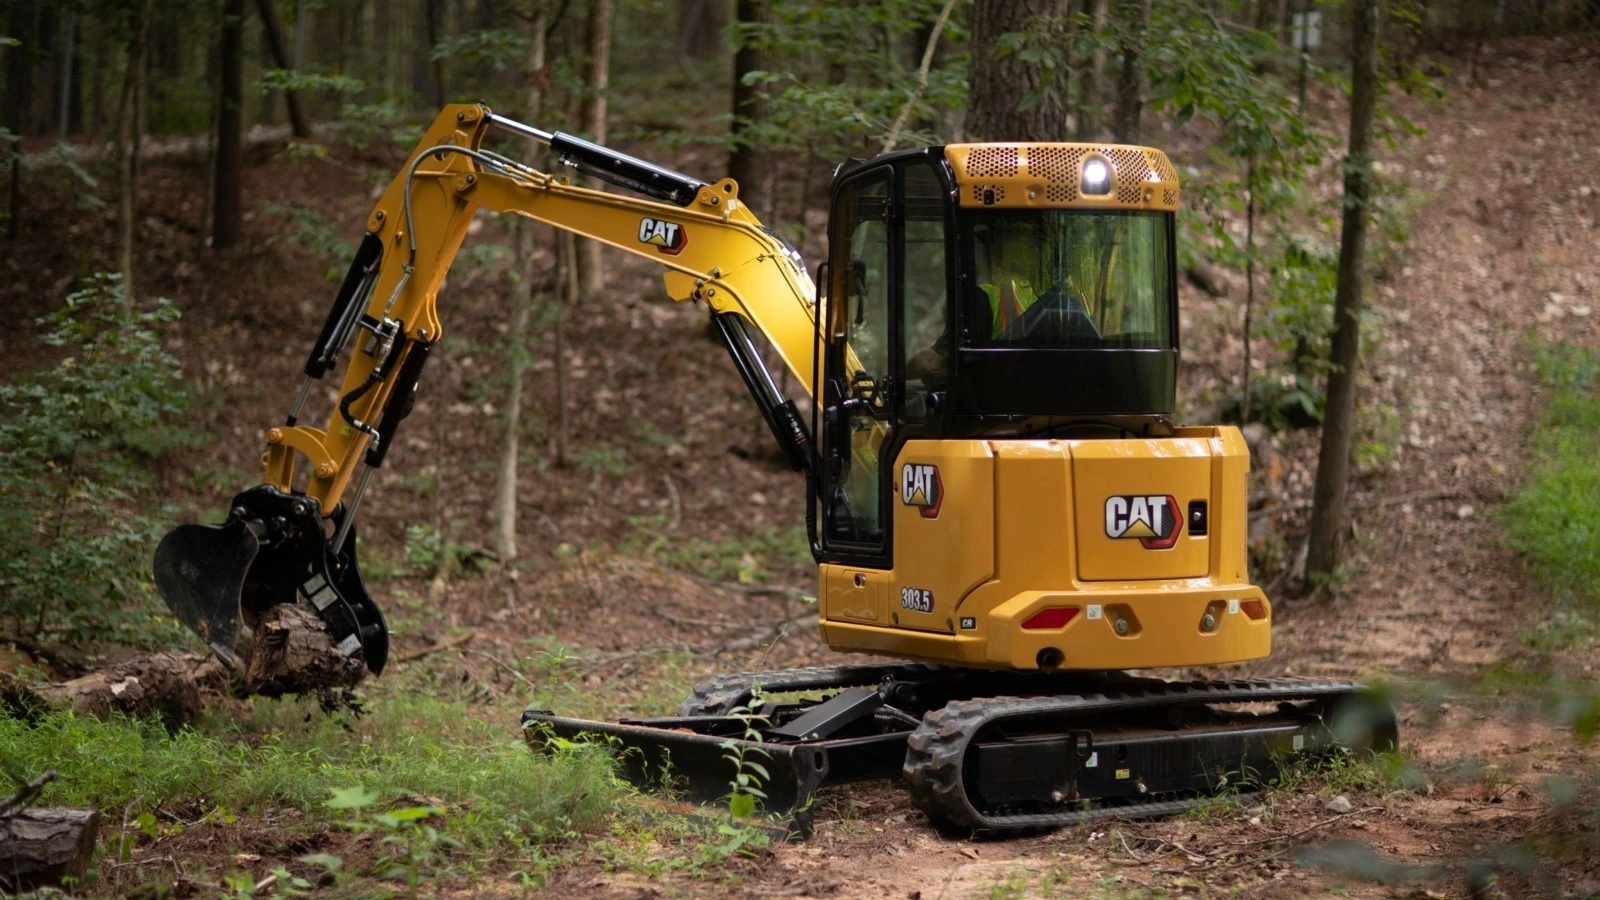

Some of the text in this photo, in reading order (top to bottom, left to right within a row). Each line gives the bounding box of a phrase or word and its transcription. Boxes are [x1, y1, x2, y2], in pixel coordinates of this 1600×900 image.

[639, 218, 679, 247] CAT
[903, 464, 934, 506] CAT
[1106, 496, 1167, 538] CAT
[901, 587, 930, 612] 303.5
[962, 618, 973, 628] CR
